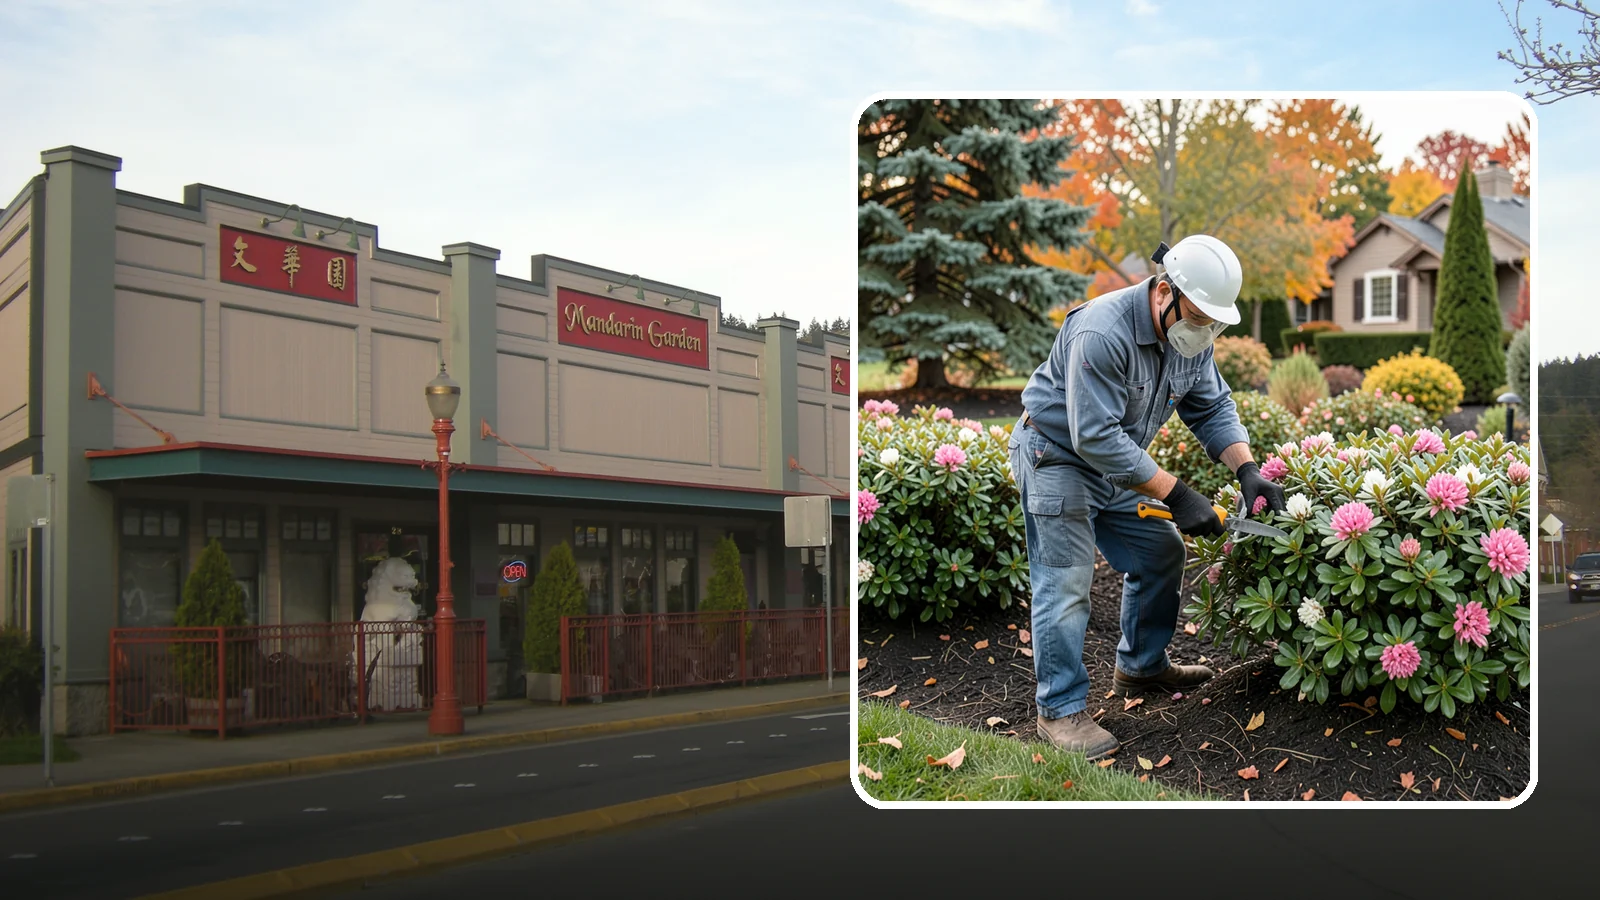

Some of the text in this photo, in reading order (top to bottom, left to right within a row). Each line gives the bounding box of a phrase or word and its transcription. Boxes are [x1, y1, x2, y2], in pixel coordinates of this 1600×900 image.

[565, 302, 702, 352] Mandarin Garden
[503, 565, 527, 578] OPEN
